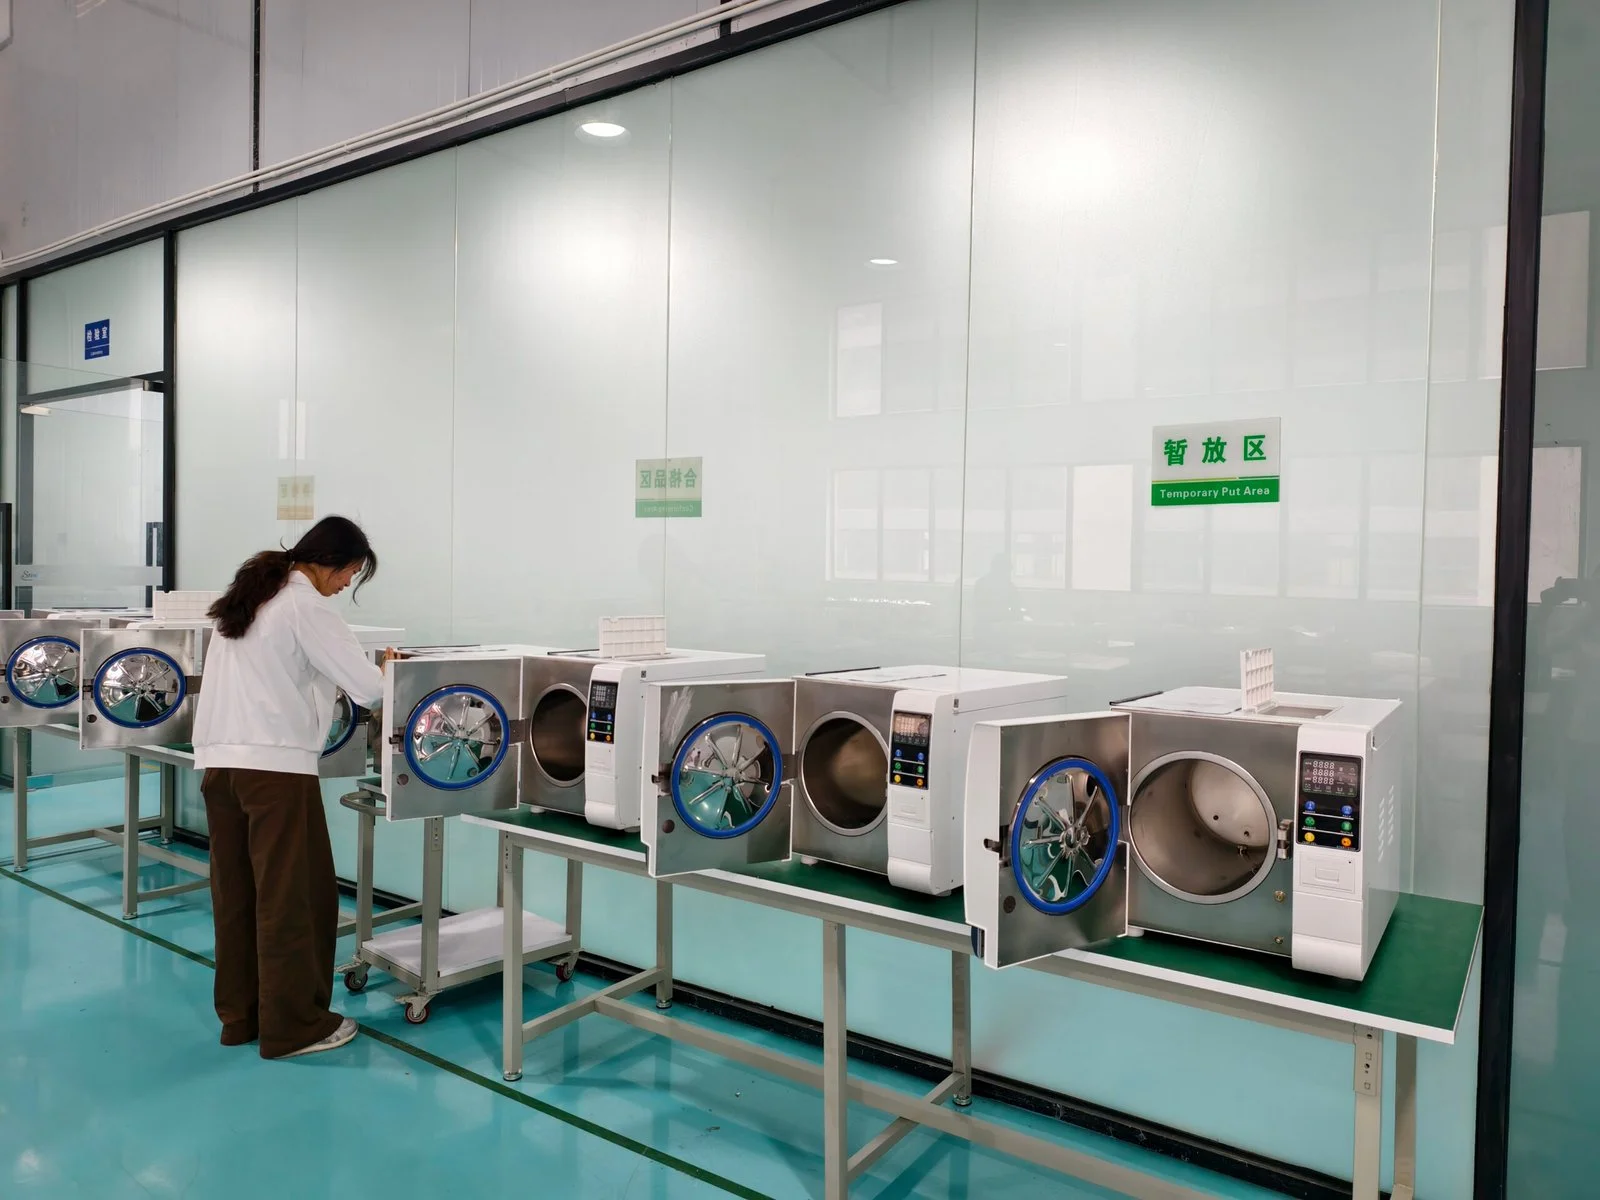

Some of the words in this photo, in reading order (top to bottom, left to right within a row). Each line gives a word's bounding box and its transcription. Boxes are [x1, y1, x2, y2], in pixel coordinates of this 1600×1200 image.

[1163, 434, 1267, 466] 暂放区
[1160, 489, 1219, 499] Temporary
[1221, 487, 1240, 497] Put
[1243, 486, 1270, 496] Area
